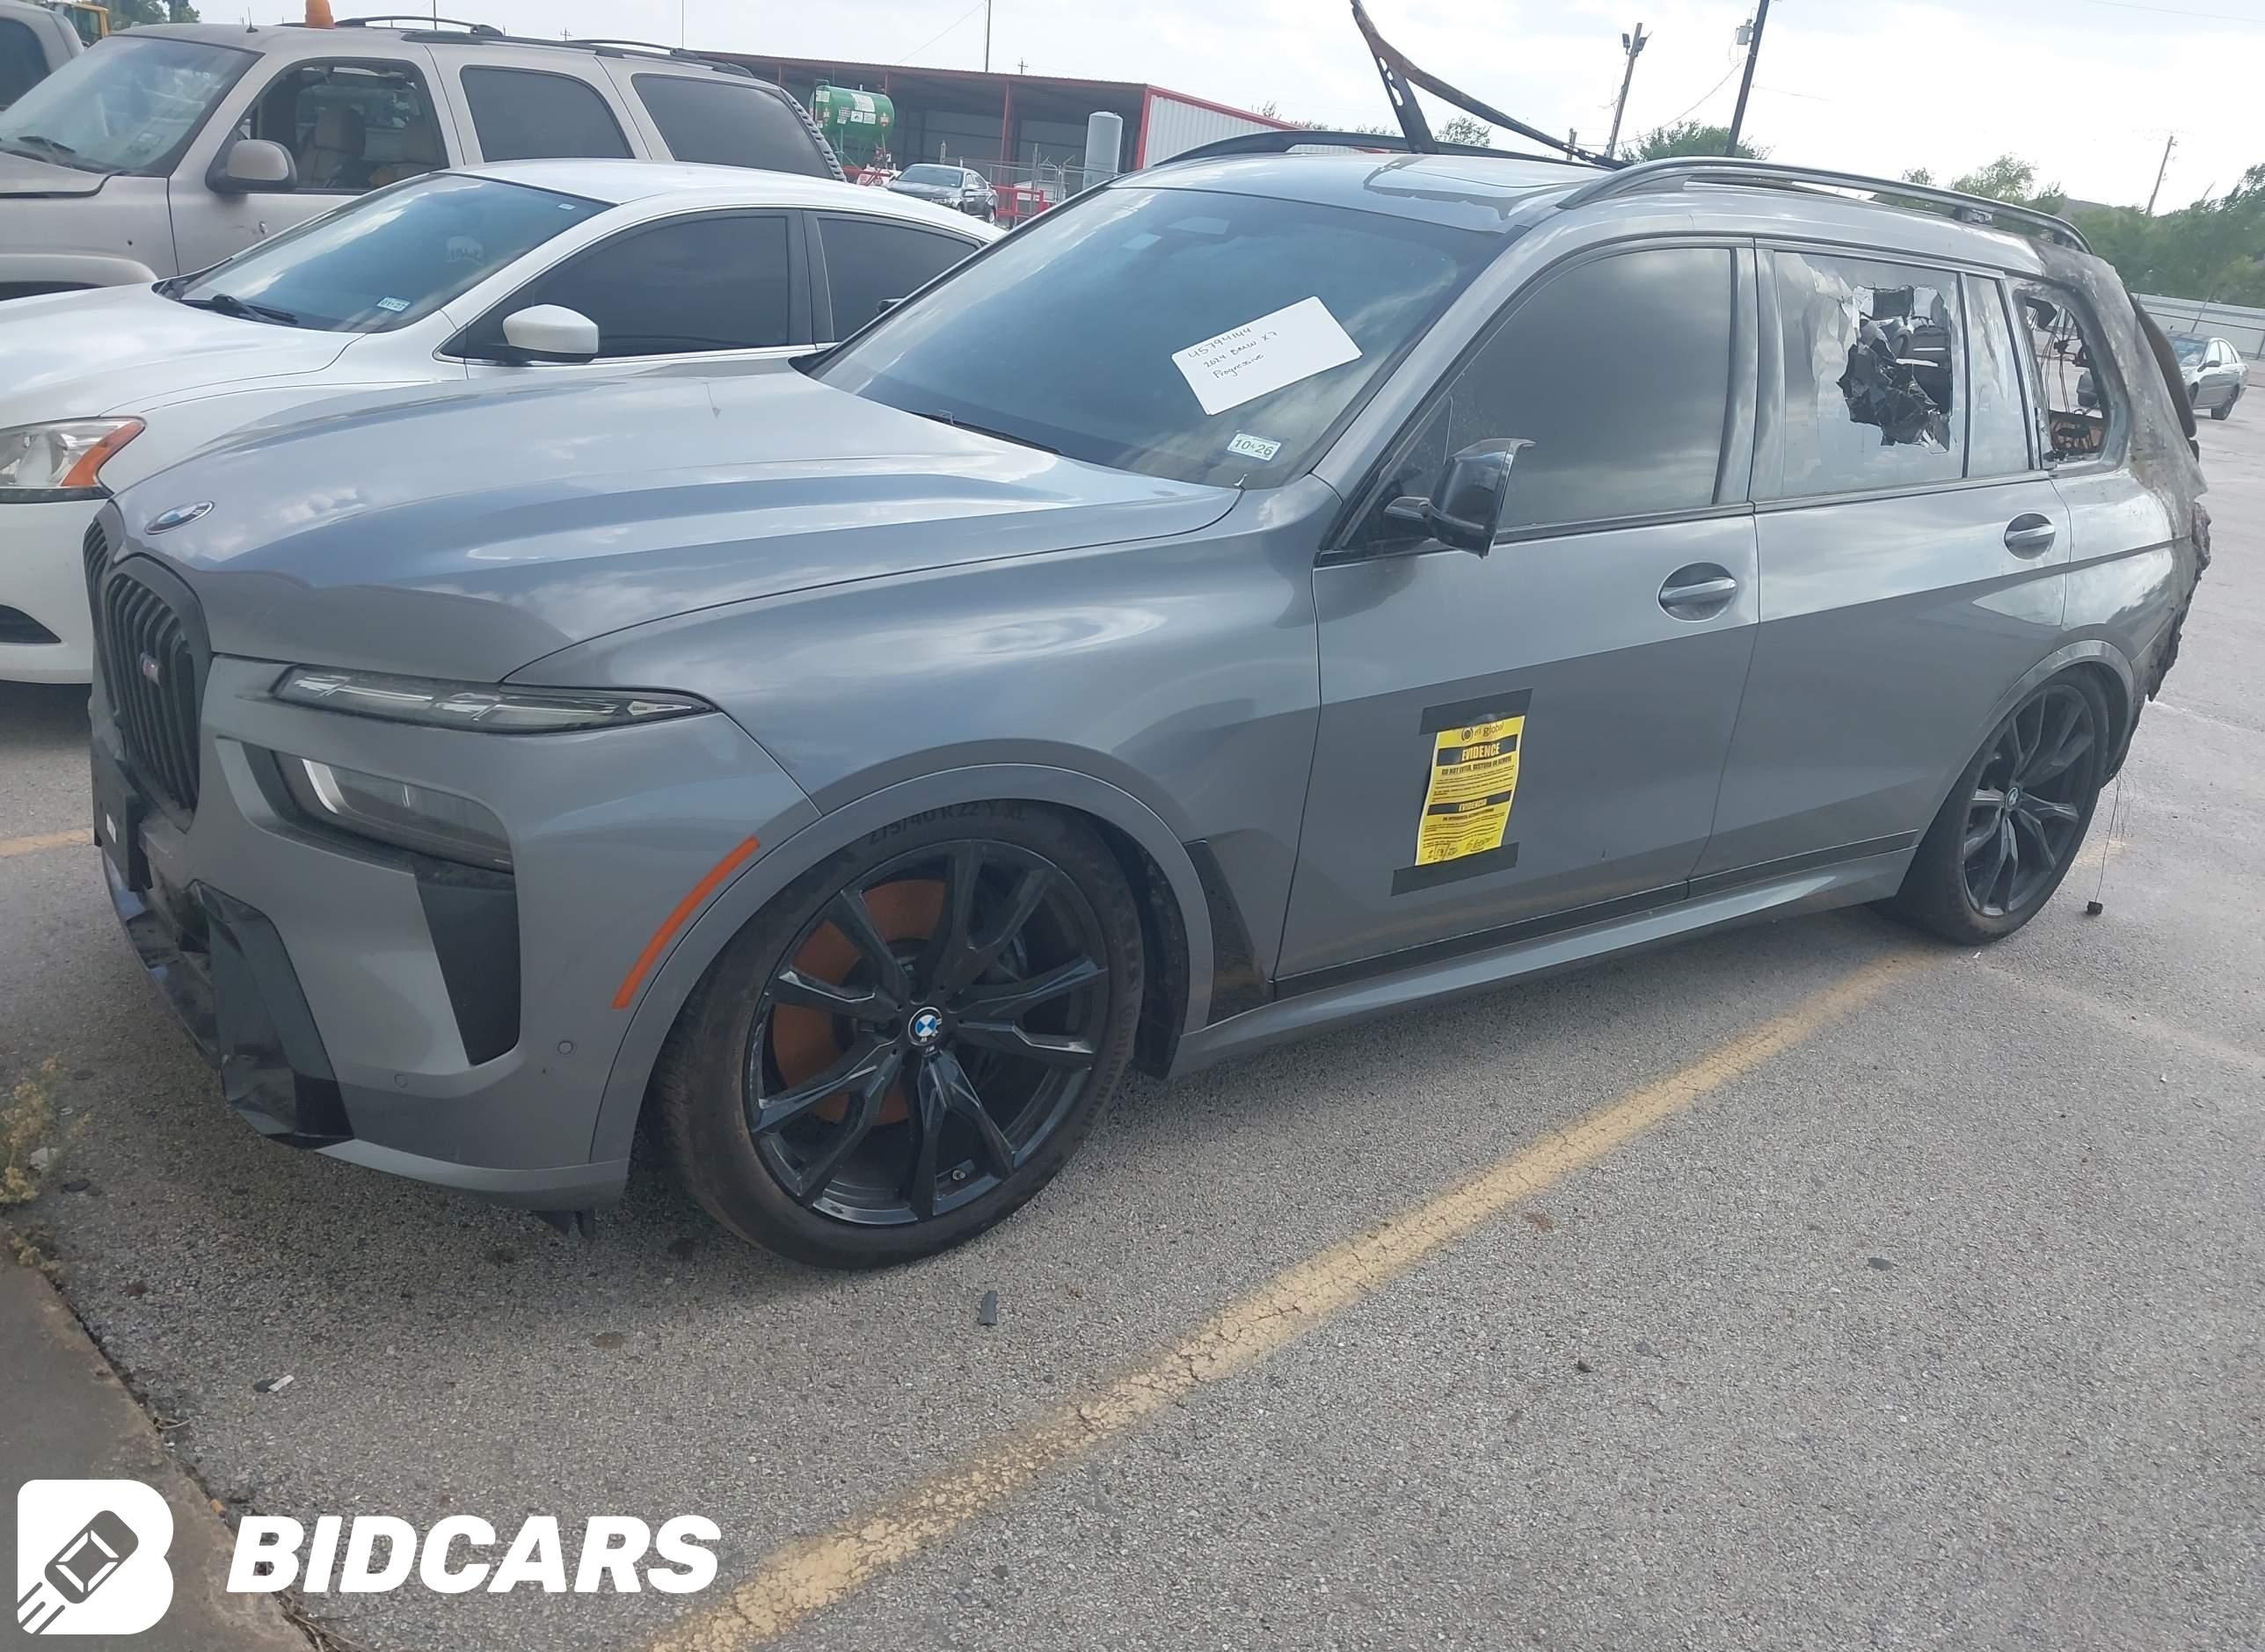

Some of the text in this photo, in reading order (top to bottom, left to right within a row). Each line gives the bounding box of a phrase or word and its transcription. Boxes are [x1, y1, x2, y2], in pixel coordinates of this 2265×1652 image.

[1203, 331, 1278, 368] 2024 BMW X7
[1213, 353, 1264, 378] Progressive
[1482, 721, 1504, 738] global
[1461, 743, 1500, 761] EVIDENCE
